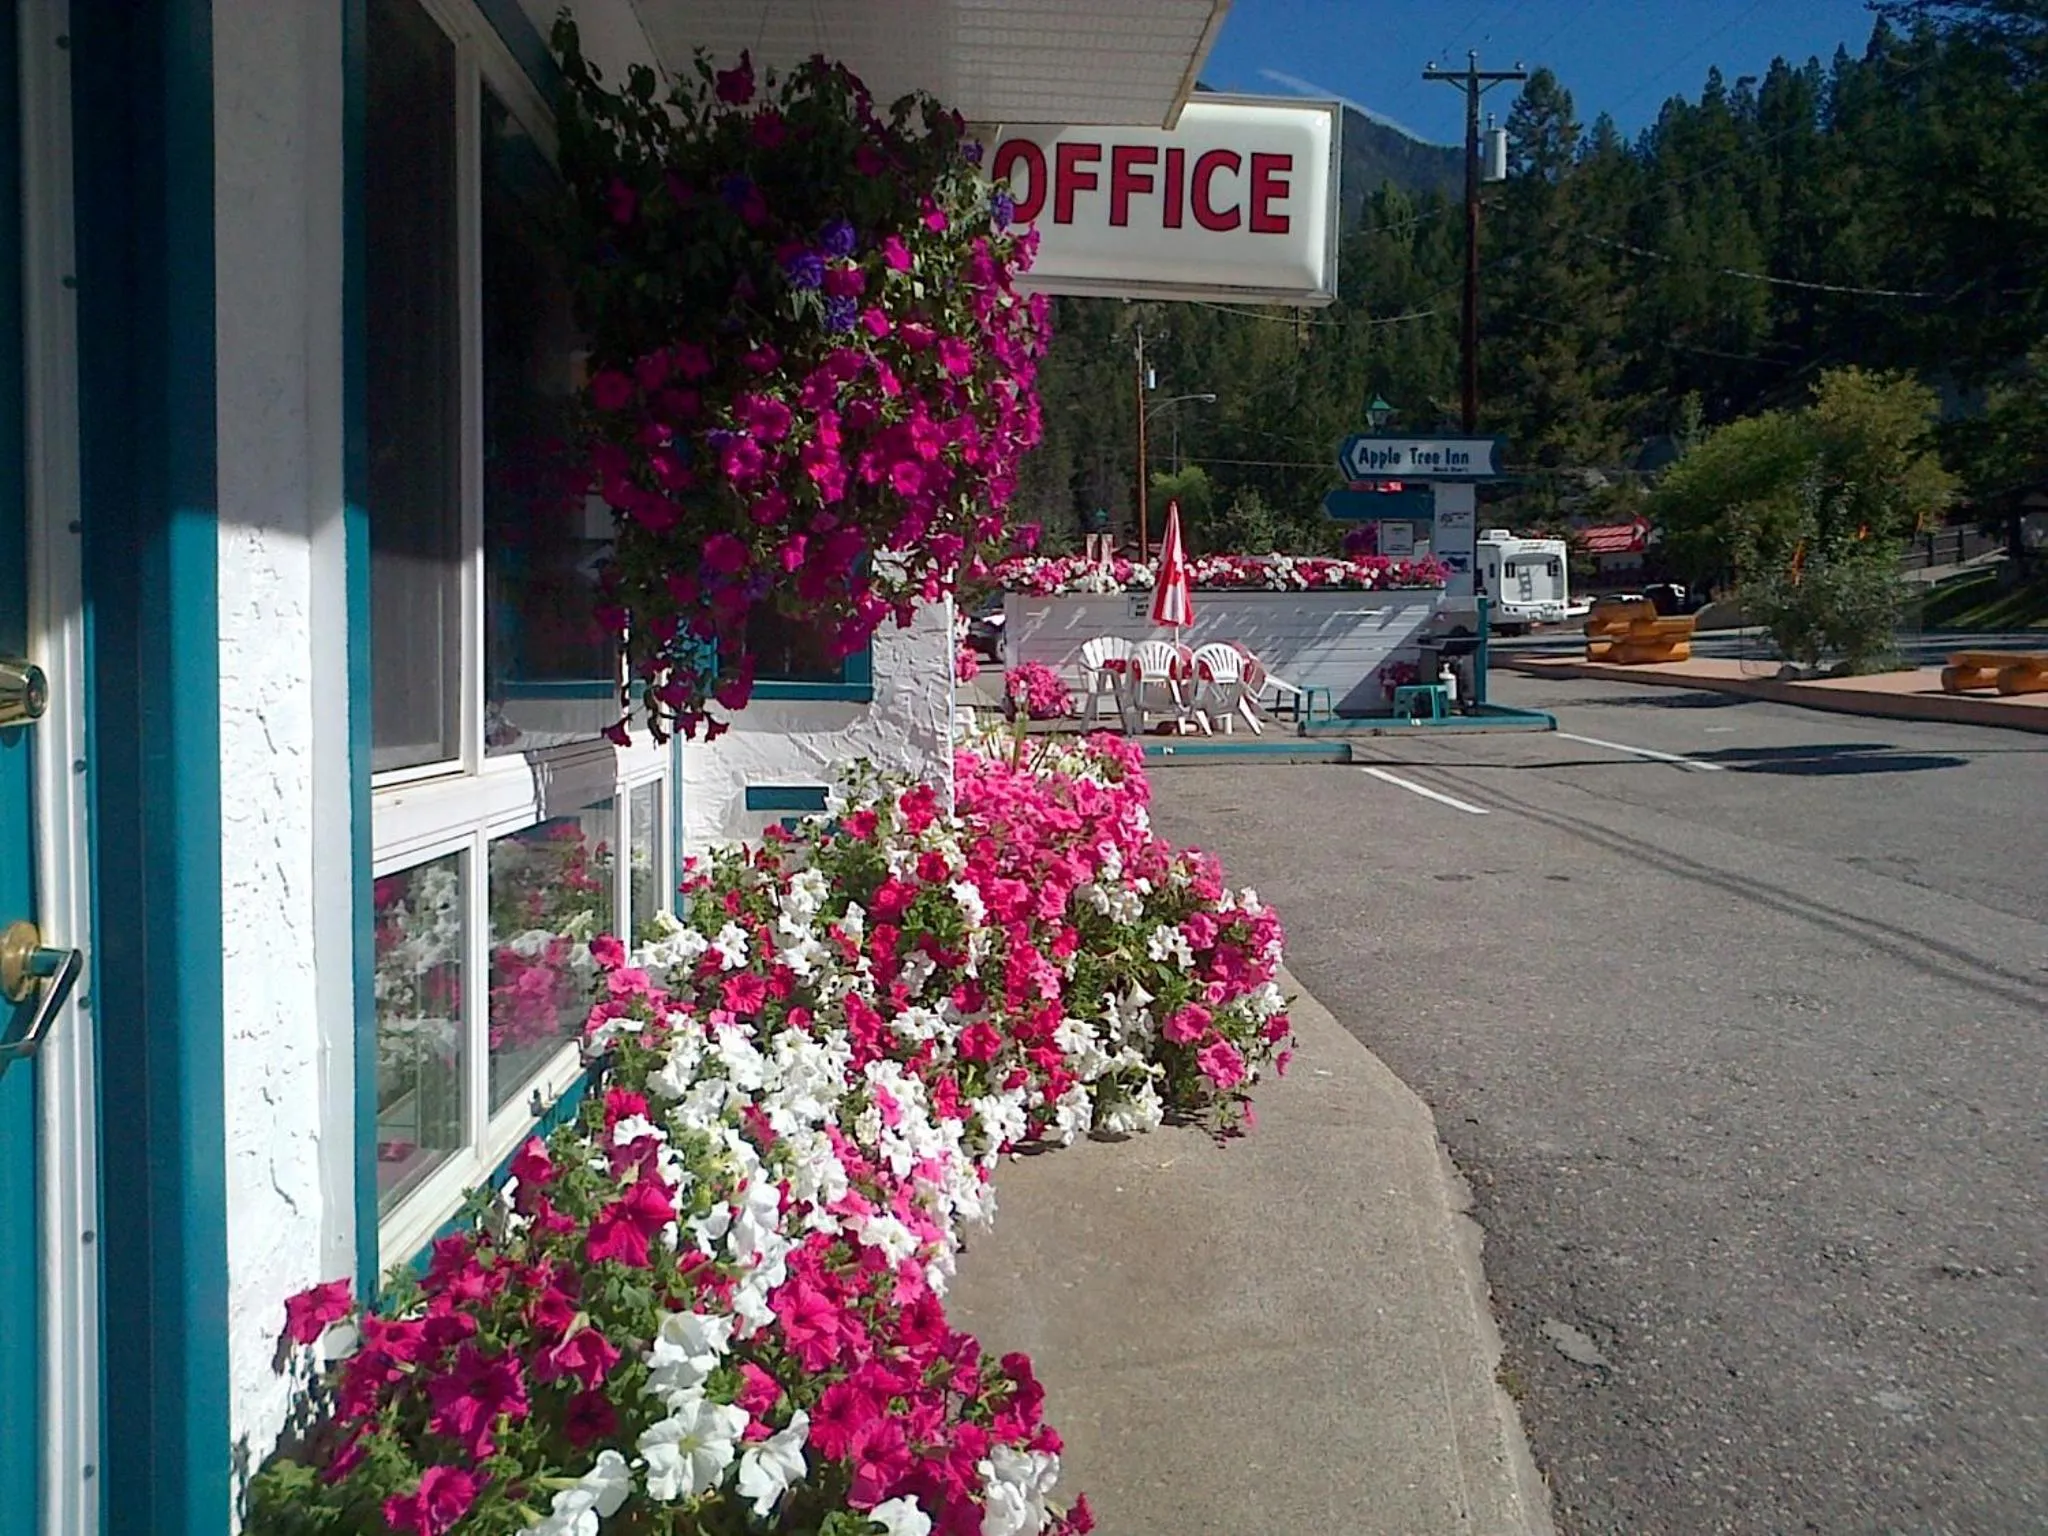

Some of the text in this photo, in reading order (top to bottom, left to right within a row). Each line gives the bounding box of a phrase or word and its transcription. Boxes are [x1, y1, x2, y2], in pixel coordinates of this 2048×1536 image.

[992, 138, 1293, 233] OFFICE
[1358, 446, 1469, 469] Apple Tree Inn
